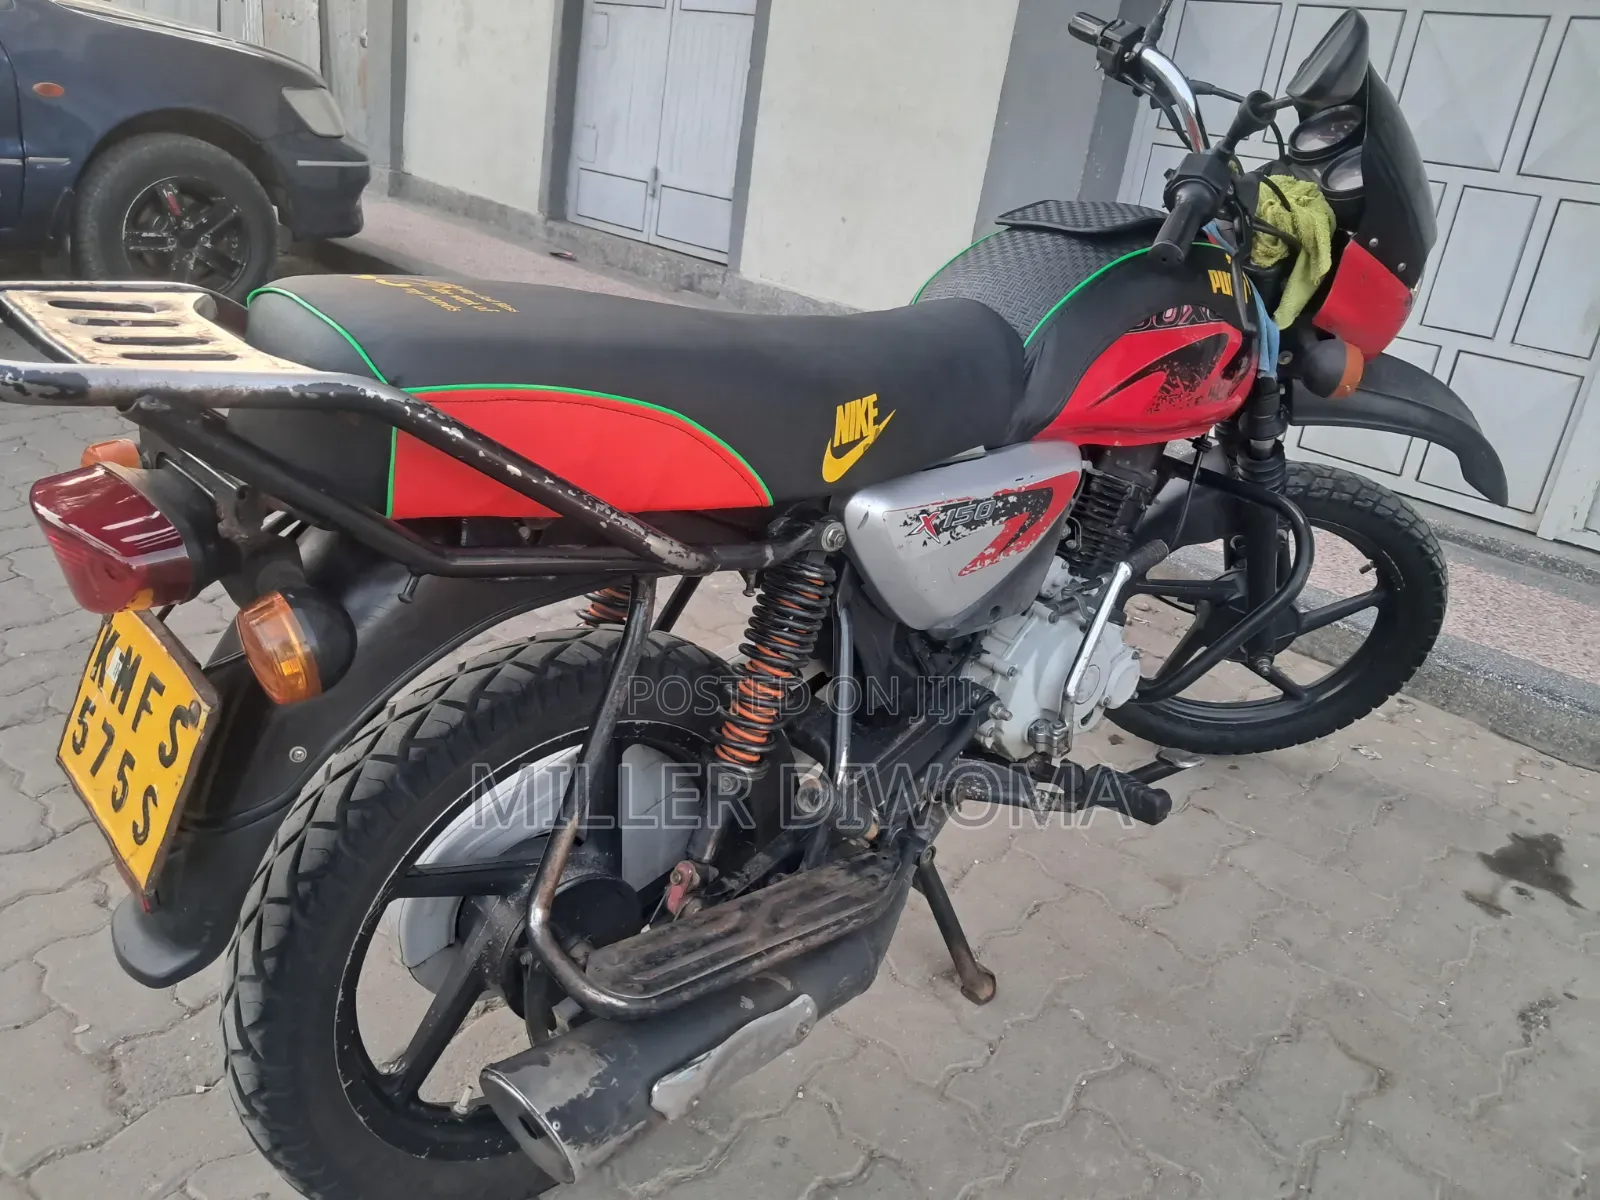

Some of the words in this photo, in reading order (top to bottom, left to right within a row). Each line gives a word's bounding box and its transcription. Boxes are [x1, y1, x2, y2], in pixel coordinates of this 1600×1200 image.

[833, 393, 879, 448] NIKE
[904, 499, 997, 544] X150
[90, 622, 201, 768] KMFS
[72, 695, 158, 846] 575S
